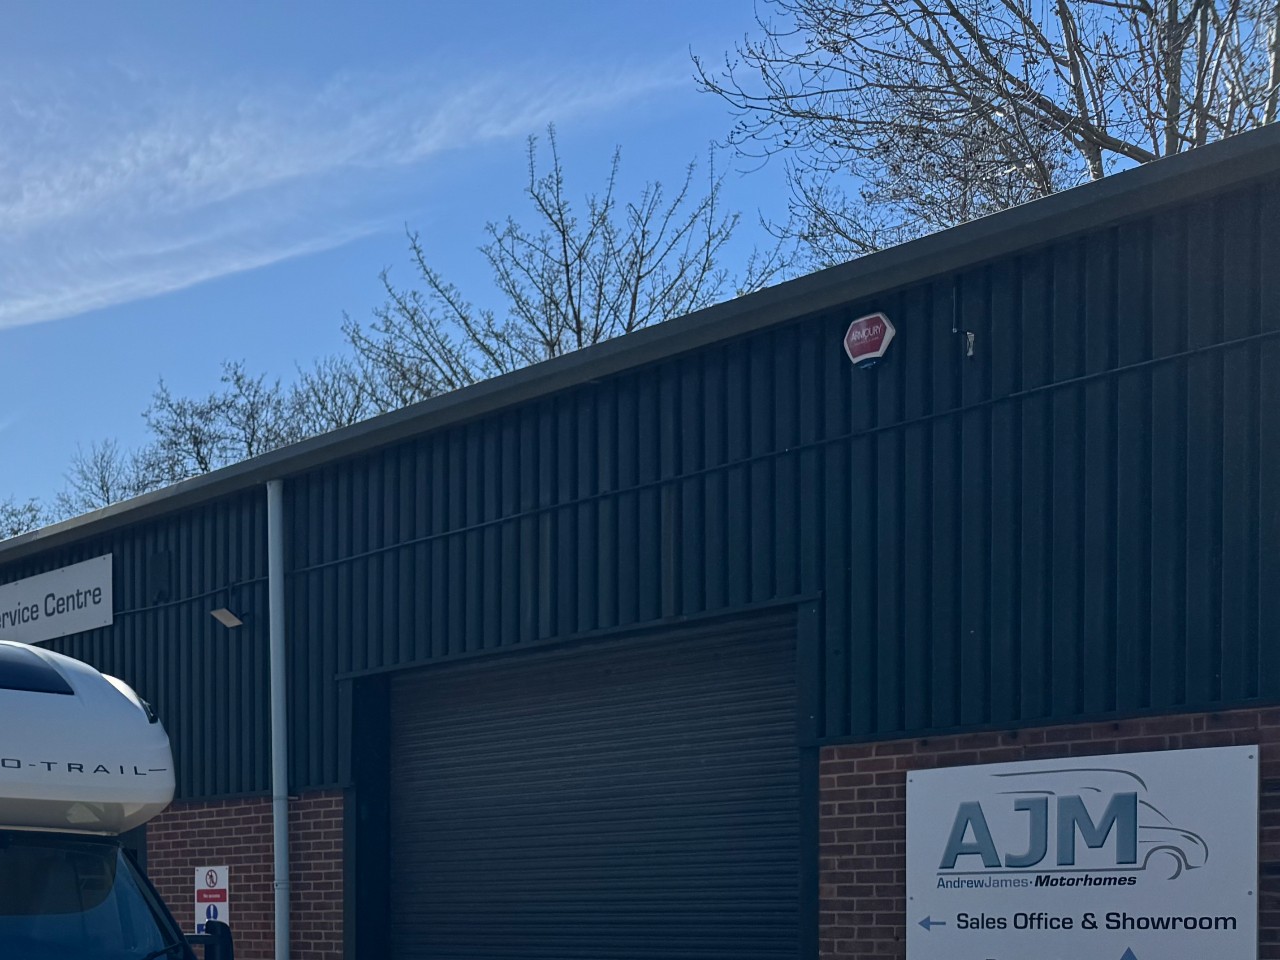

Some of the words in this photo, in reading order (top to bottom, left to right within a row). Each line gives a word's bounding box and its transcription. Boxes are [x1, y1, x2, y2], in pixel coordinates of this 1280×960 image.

[44, 586, 102, 618] Centre
[938, 791, 1138, 870] AJM
[956, 912, 1007, 930] Sales
[1013, 912, 1074, 930] Office
[1081, 912, 1099, 930] &
[1105, 911, 1237, 930] Showroom
